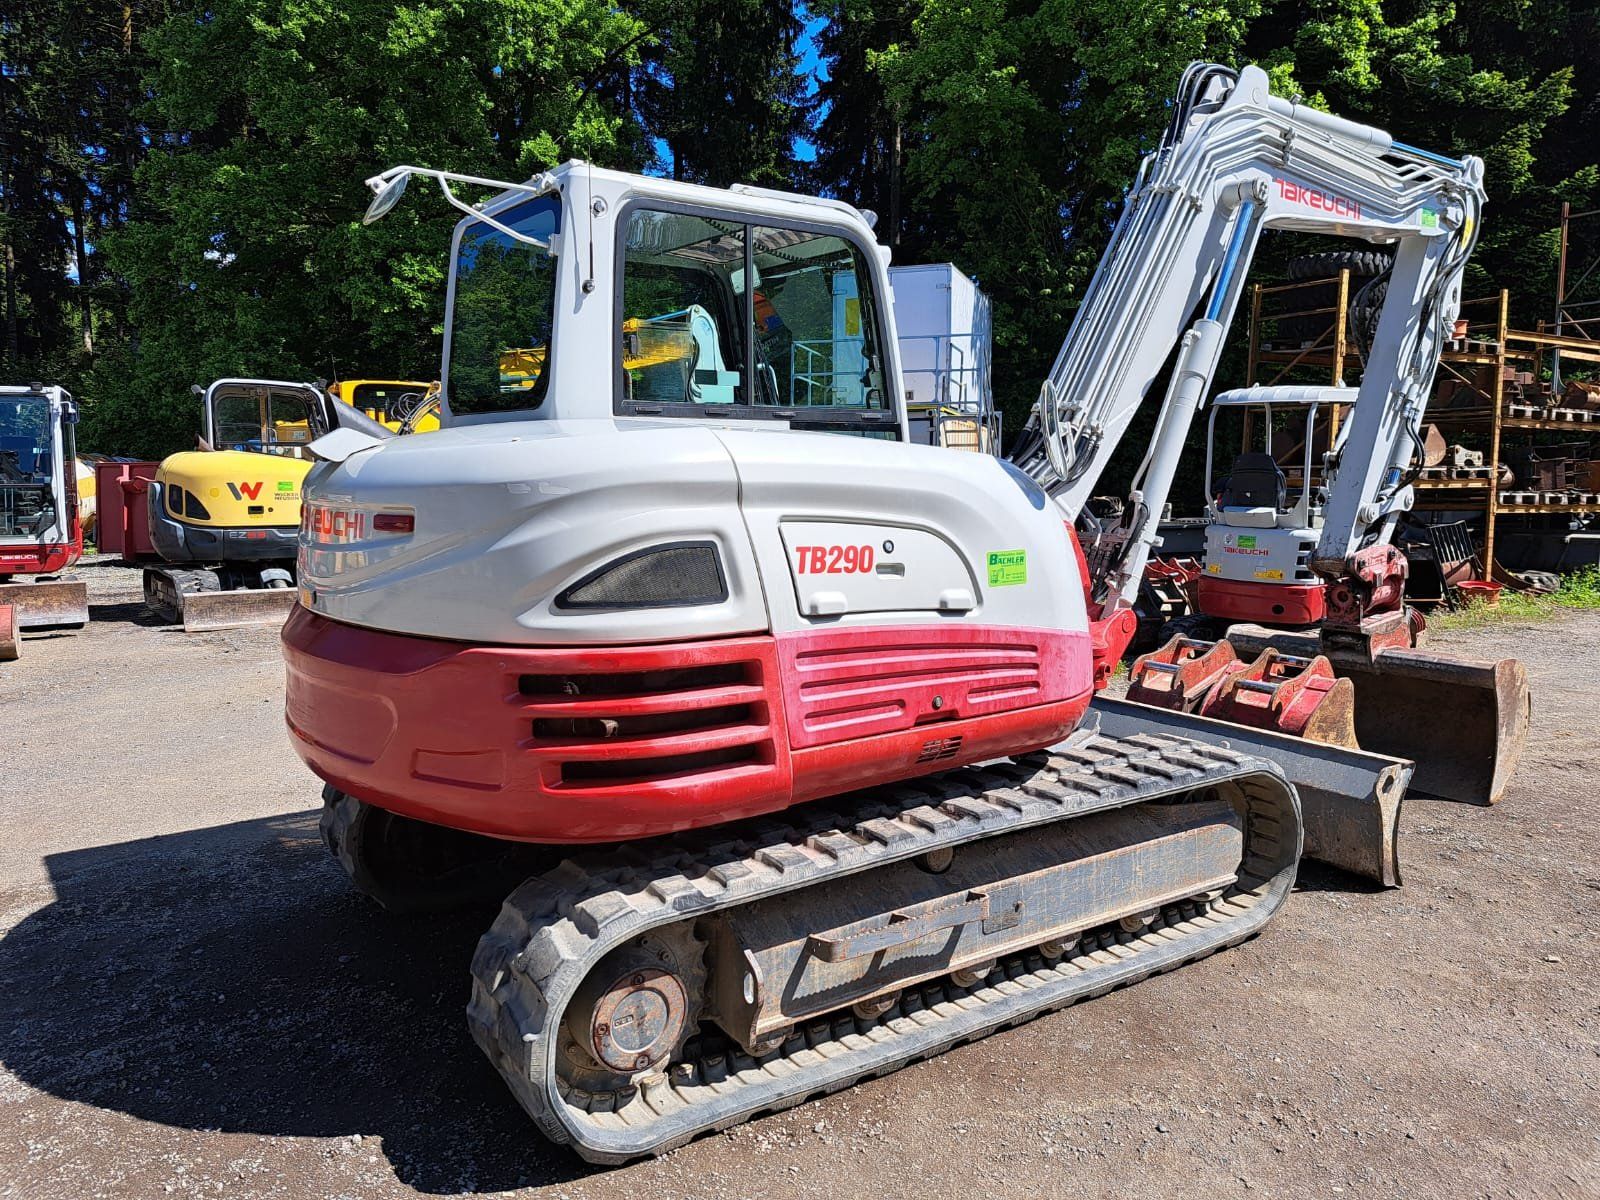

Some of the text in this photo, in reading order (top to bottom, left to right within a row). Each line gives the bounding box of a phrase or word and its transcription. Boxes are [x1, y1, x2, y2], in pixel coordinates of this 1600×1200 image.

[1274, 177, 1360, 220] TAKEUCHI
[795, 545, 874, 574] TB290
[1223, 546, 1268, 556] TAKEUCHI
